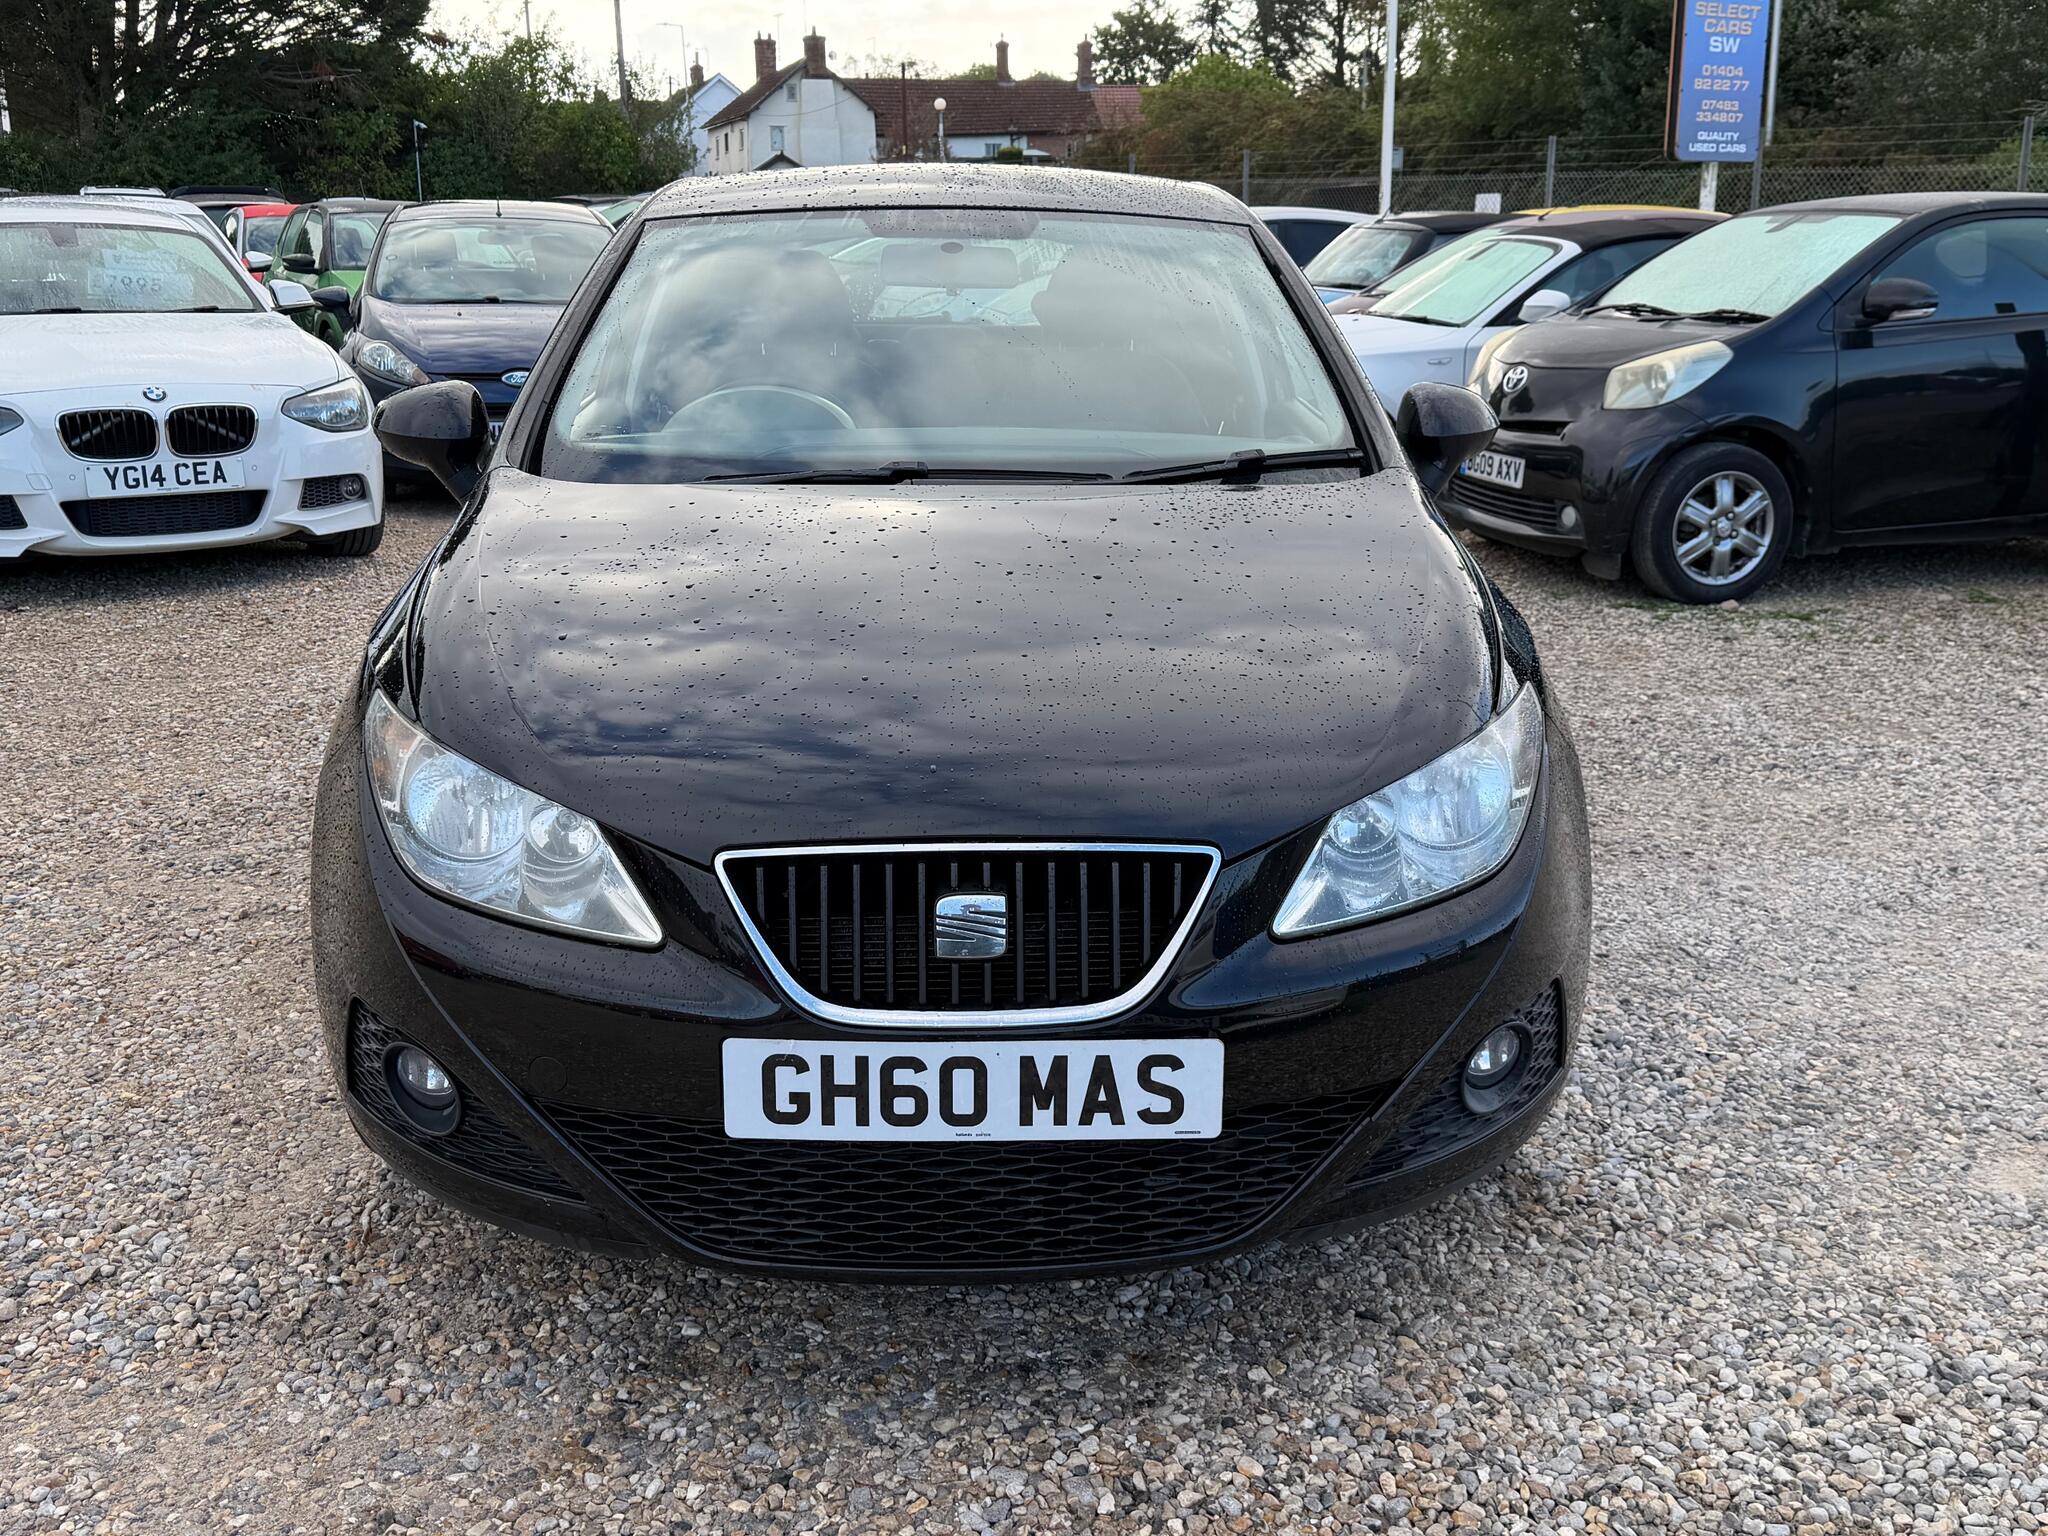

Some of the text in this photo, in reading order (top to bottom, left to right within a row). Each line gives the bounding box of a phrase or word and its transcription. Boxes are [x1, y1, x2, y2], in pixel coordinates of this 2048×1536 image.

[1694, 2, 1761, 19] SELECT
[1704, 19, 1753, 35] CARS
[1708, 36, 1741, 53] SW
[1702, 64, 1744, 77] 01404
[1697, 130, 1740, 142] QUALITY
[1688, 142, 1747, 153] USED CARS
[103, 461, 228, 490] YG14 CEA
[761, 1053, 1185, 1127] GH60 MAS
